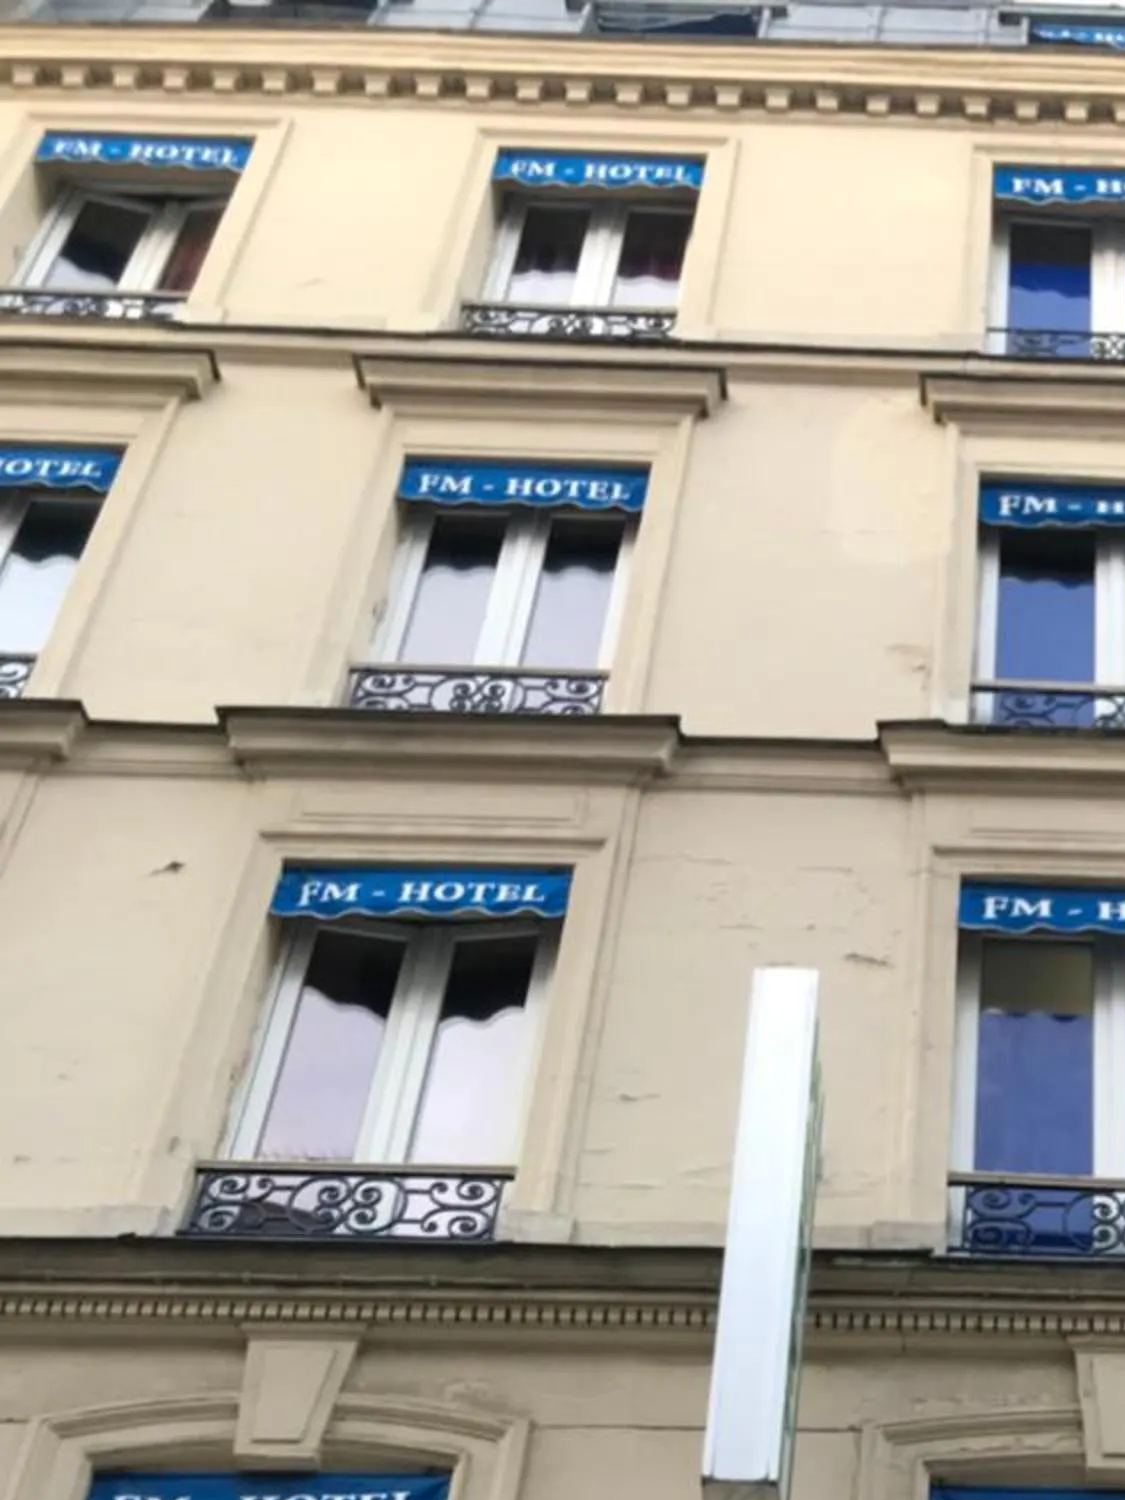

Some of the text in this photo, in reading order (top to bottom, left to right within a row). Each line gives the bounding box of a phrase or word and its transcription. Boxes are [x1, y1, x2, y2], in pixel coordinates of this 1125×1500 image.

[511, 160, 556, 177] FM
[585, 162, 692, 182] HOTEL
[1012, 177, 1064, 194] FM
[0, 457, 102, 478] OTEL
[418, 473, 474, 495] FM
[505, 477, 630, 501] HOTEL
[998, 494, 1058, 516] FM
[297, 880, 362, 907] FM
[397, 881, 545, 902] HOTEL
[982, 896, 1054, 920] FM
